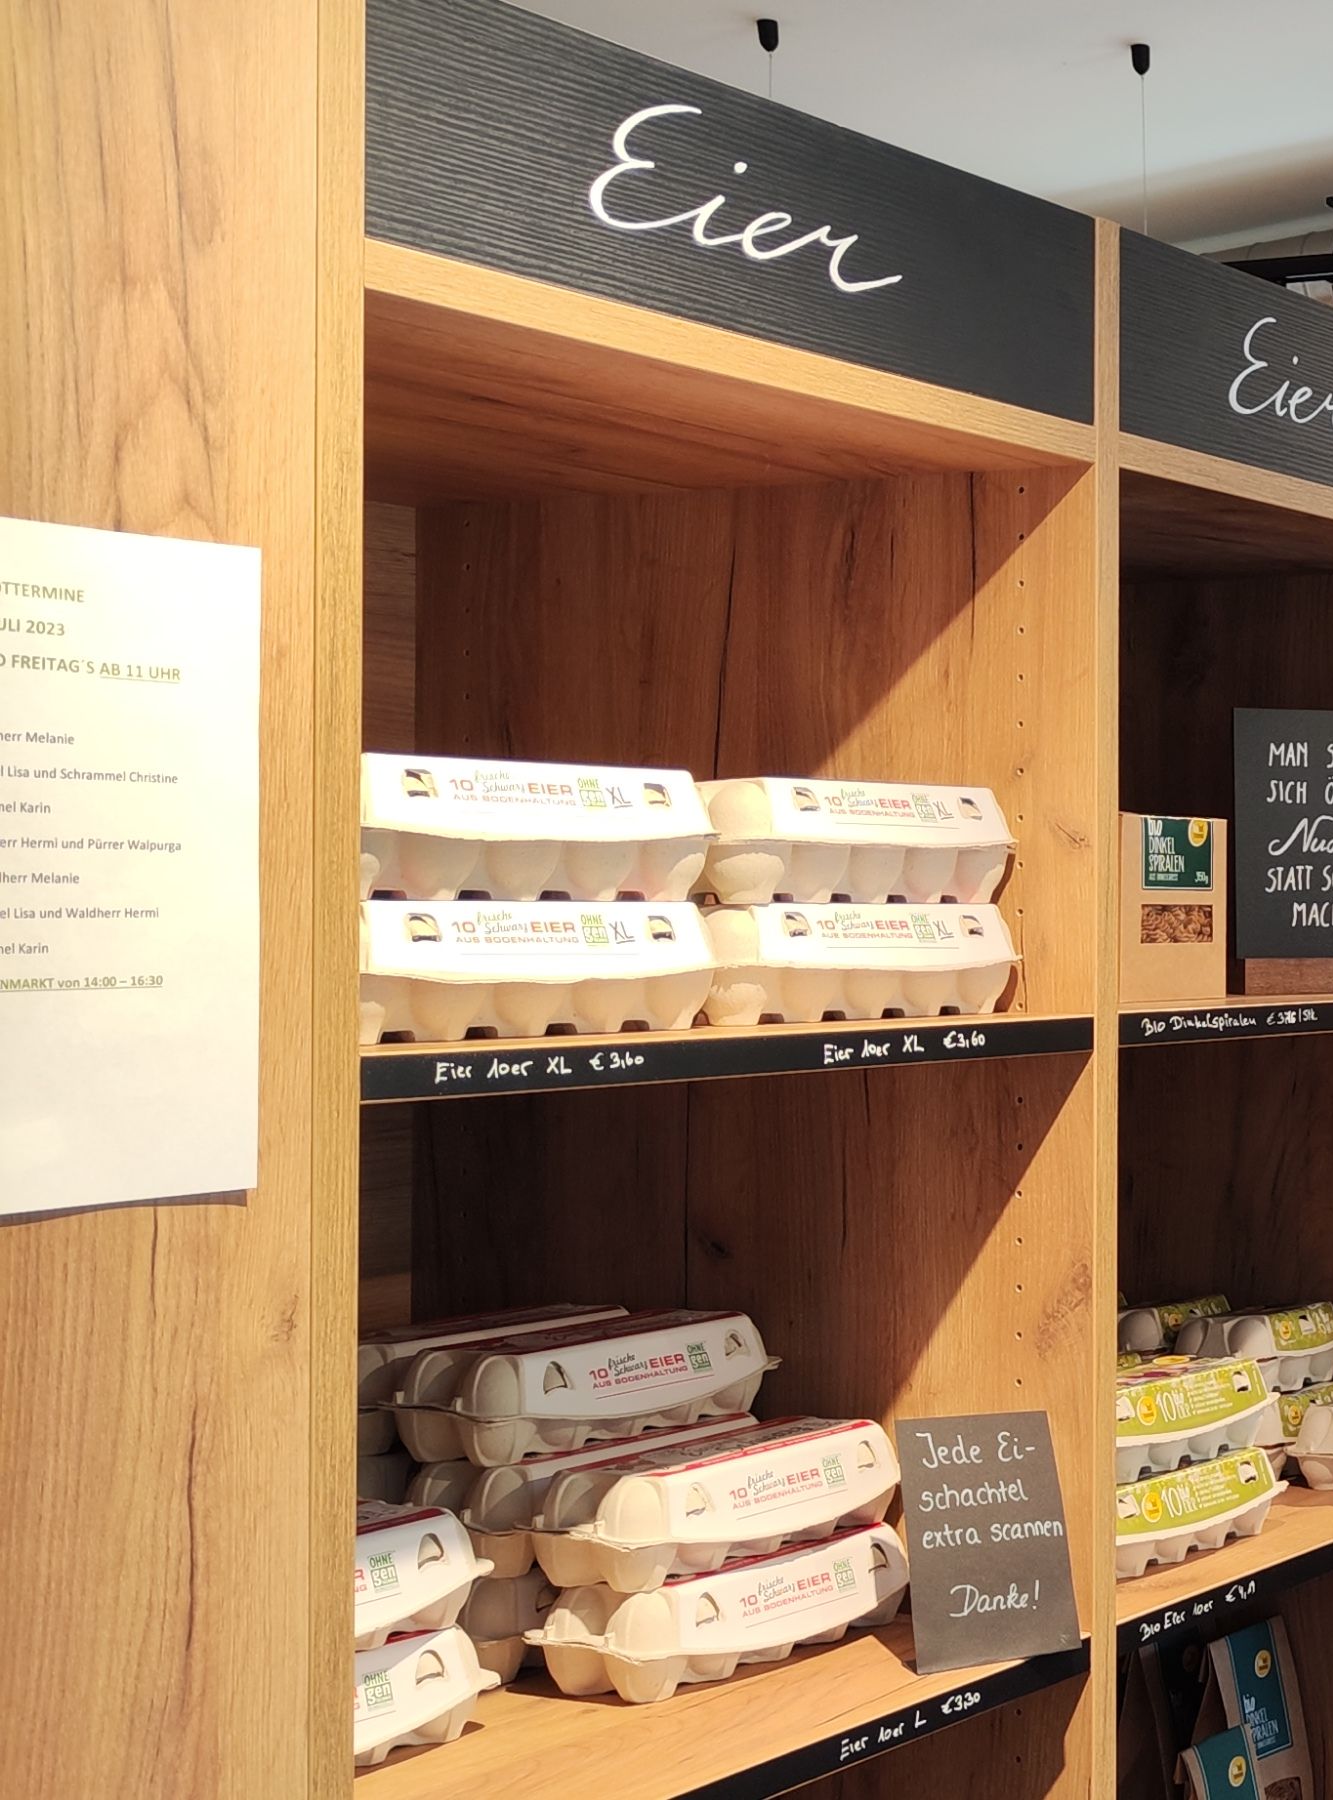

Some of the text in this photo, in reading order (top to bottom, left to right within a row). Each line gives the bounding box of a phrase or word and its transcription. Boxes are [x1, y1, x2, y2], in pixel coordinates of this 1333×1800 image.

[589, 104, 903, 293] Eier
[0, 581, 85, 603] TTERMINE
[26, 619, 65, 636] 2023
[100, 662, 121, 677] AB
[127, 664, 143, 679] 11
[149, 666, 181, 681] UHR
[25, 731, 75, 745] Melanie
[1268, 742, 1309, 768] MAN
[7, 765, 30, 778] Lisa
[33, 768, 57, 779] und
[60, 767, 126, 782] Schrammel
[129, 771, 178, 784] Christine
[577, 778, 600, 789] OHNE
[450, 778, 474, 791] 10
[527, 782, 574, 796] EIER
[605, 786, 633, 805] XL
[1266, 780, 1308, 804] SICH
[20, 801, 51, 814] Karin
[824, 796, 842, 808] 10
[879, 798, 912, 810] EIER
[933, 801, 953, 817] XL
[20, 836, 58, 849] Hermi
[61, 838, 84, 849] und
[88, 838, 124, 850] Pürrer
[127, 839, 182, 854] Walpurga
[1148, 836, 1175, 854] DINKEL
[1148, 854, 1185, 873] SPIRALEN
[31, 872, 80, 884] Melanie
[1264, 866, 1313, 893] STATT
[14, 907, 159, 919] Lisa und Waldherr Hermi
[580, 914, 603, 925] OHNE
[452, 921, 476, 933] 10
[531, 921, 576, 934] EIER
[608, 920, 635, 941] XL
[817, 920, 835, 930] 10
[875, 920, 910, 930] EIER
[933, 920, 953, 937] XL
[18, 942, 49, 954] Karin
[57, 978, 80, 988] von
[84, 976, 117, 988] 14:00
[130, 975, 163, 987] 16:30
[1169, 1012, 1257, 1032] Dinkelspiralen
[823, 1043, 855, 1066] Eier
[861, 1039, 890, 1058] 10er
[901, 1034, 925, 1054] XL
[435, 1061, 472, 1085] Eier
[487, 1058, 533, 1080] 10er
[546, 1056, 572, 1076] XL
[686, 1342, 706, 1354] OHNE
[588, 1367, 609, 1382] 10
[649, 1353, 686, 1370] EIER
[592, 1365, 688, 1390] AUS BODENHALTUNG
[1156, 1391, 1178, 1423] 10
[915, 1431, 1036, 1469] Jede Ei-
[822, 1455, 840, 1468] OHNE
[729, 1486, 748, 1501] 10
[786, 1468, 821, 1486] EIER
[732, 1480, 823, 1511] AUS BODENHALTUNG
[918, 1478, 1029, 1512] schachtel
[1161, 1487, 1184, 1518] 10
[922, 1520, 1064, 1549] extra scannen
[369, 1553, 393, 1569] OHNE
[833, 1559, 851, 1572] OHNE
[372, 1567, 397, 1587] gen
[739, 1594, 758, 1608] 10
[797, 1572, 832, 1591] EIER
[949, 1580, 1041, 1618] Danke!
[742, 1584, 834, 1618] AUS BODENHALTUNG
[364, 1671, 390, 1685] OHNE
[366, 1684, 393, 1705] gen
[839, 1735, 867, 1762] Eier
[914, 1709, 928, 1730] L
